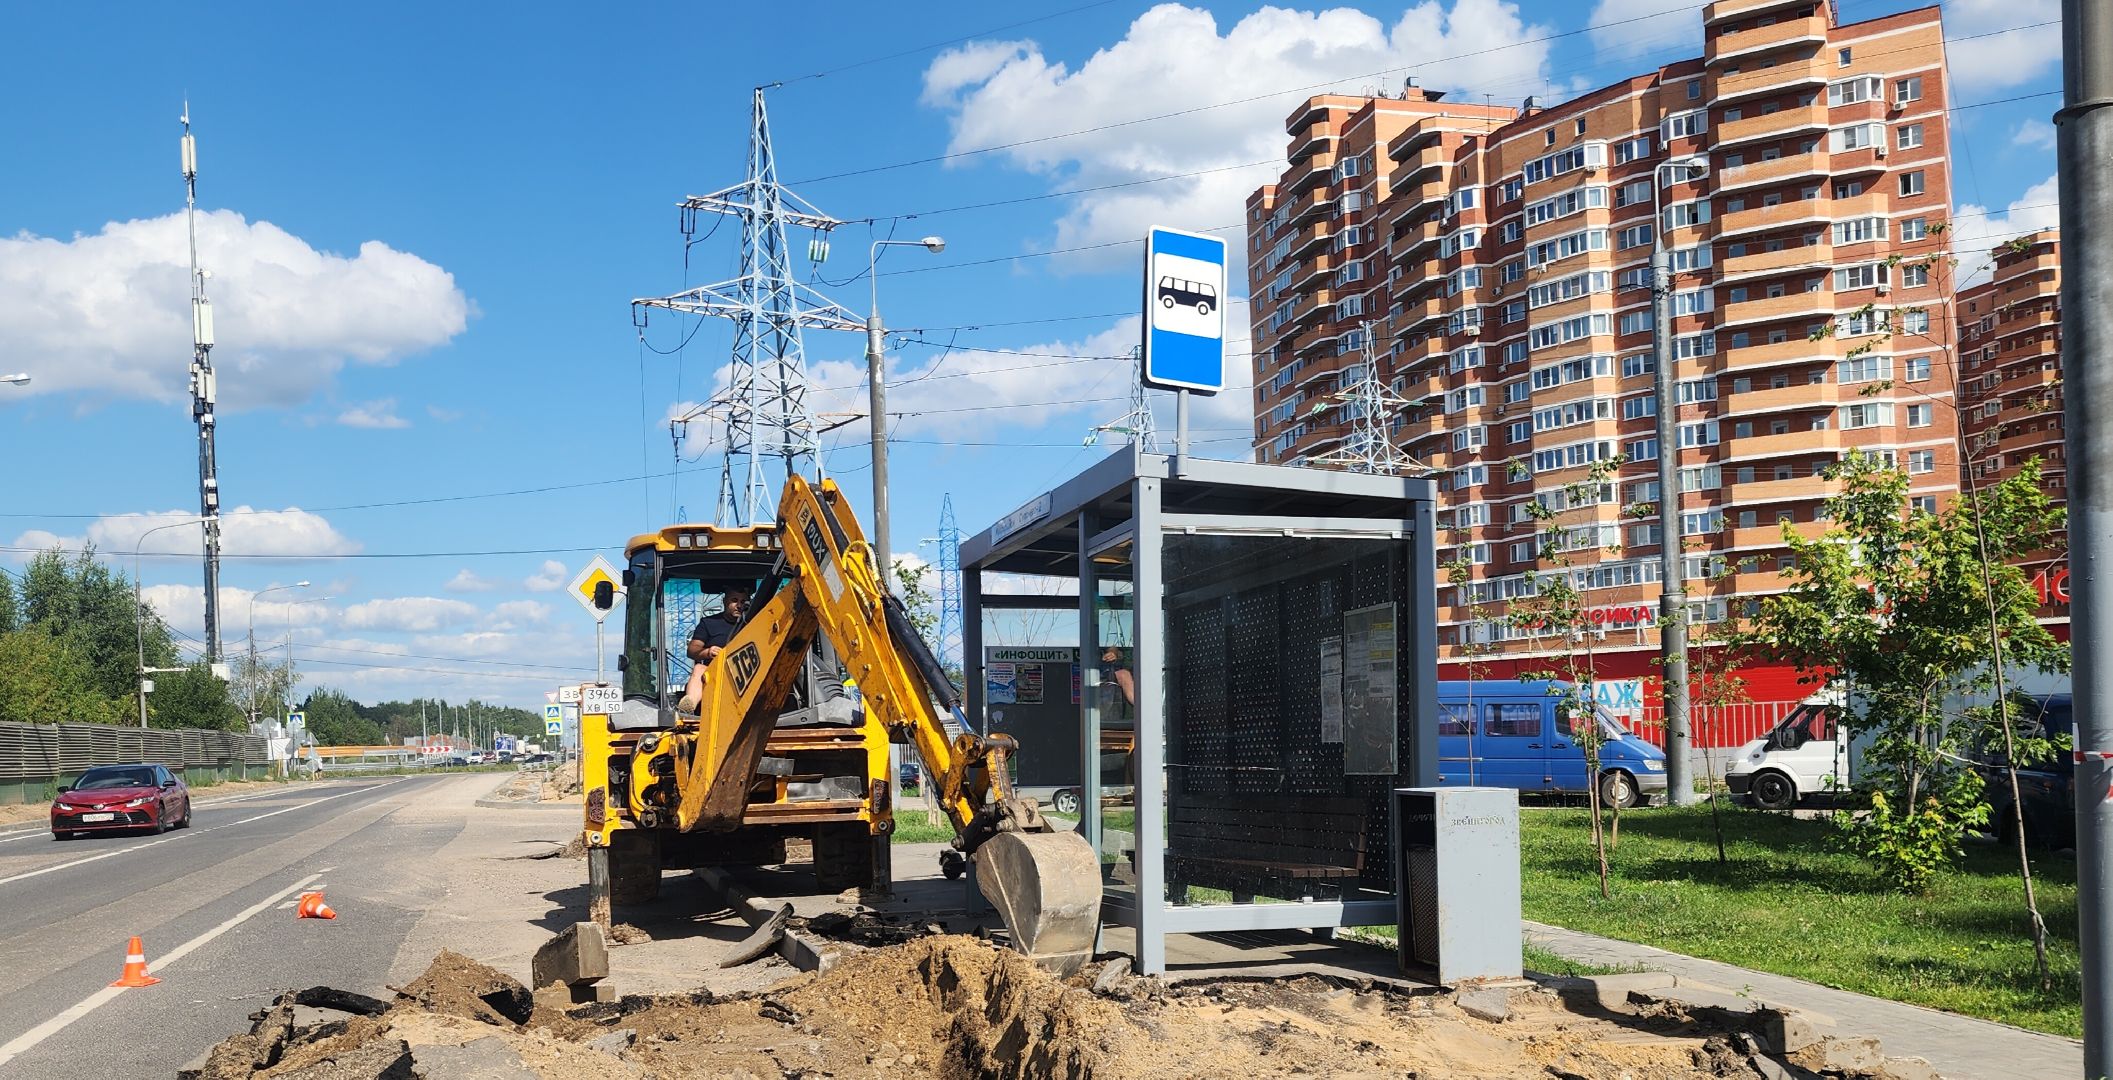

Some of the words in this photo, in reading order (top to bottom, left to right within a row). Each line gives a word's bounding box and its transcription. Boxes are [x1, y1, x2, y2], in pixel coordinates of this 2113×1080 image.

[994, 650, 1069, 661] «ИНФОЩИТ»
[732, 644, 759, 692] JCB
[588, 689, 618, 700] 3966
[608, 703, 620, 712] 50
